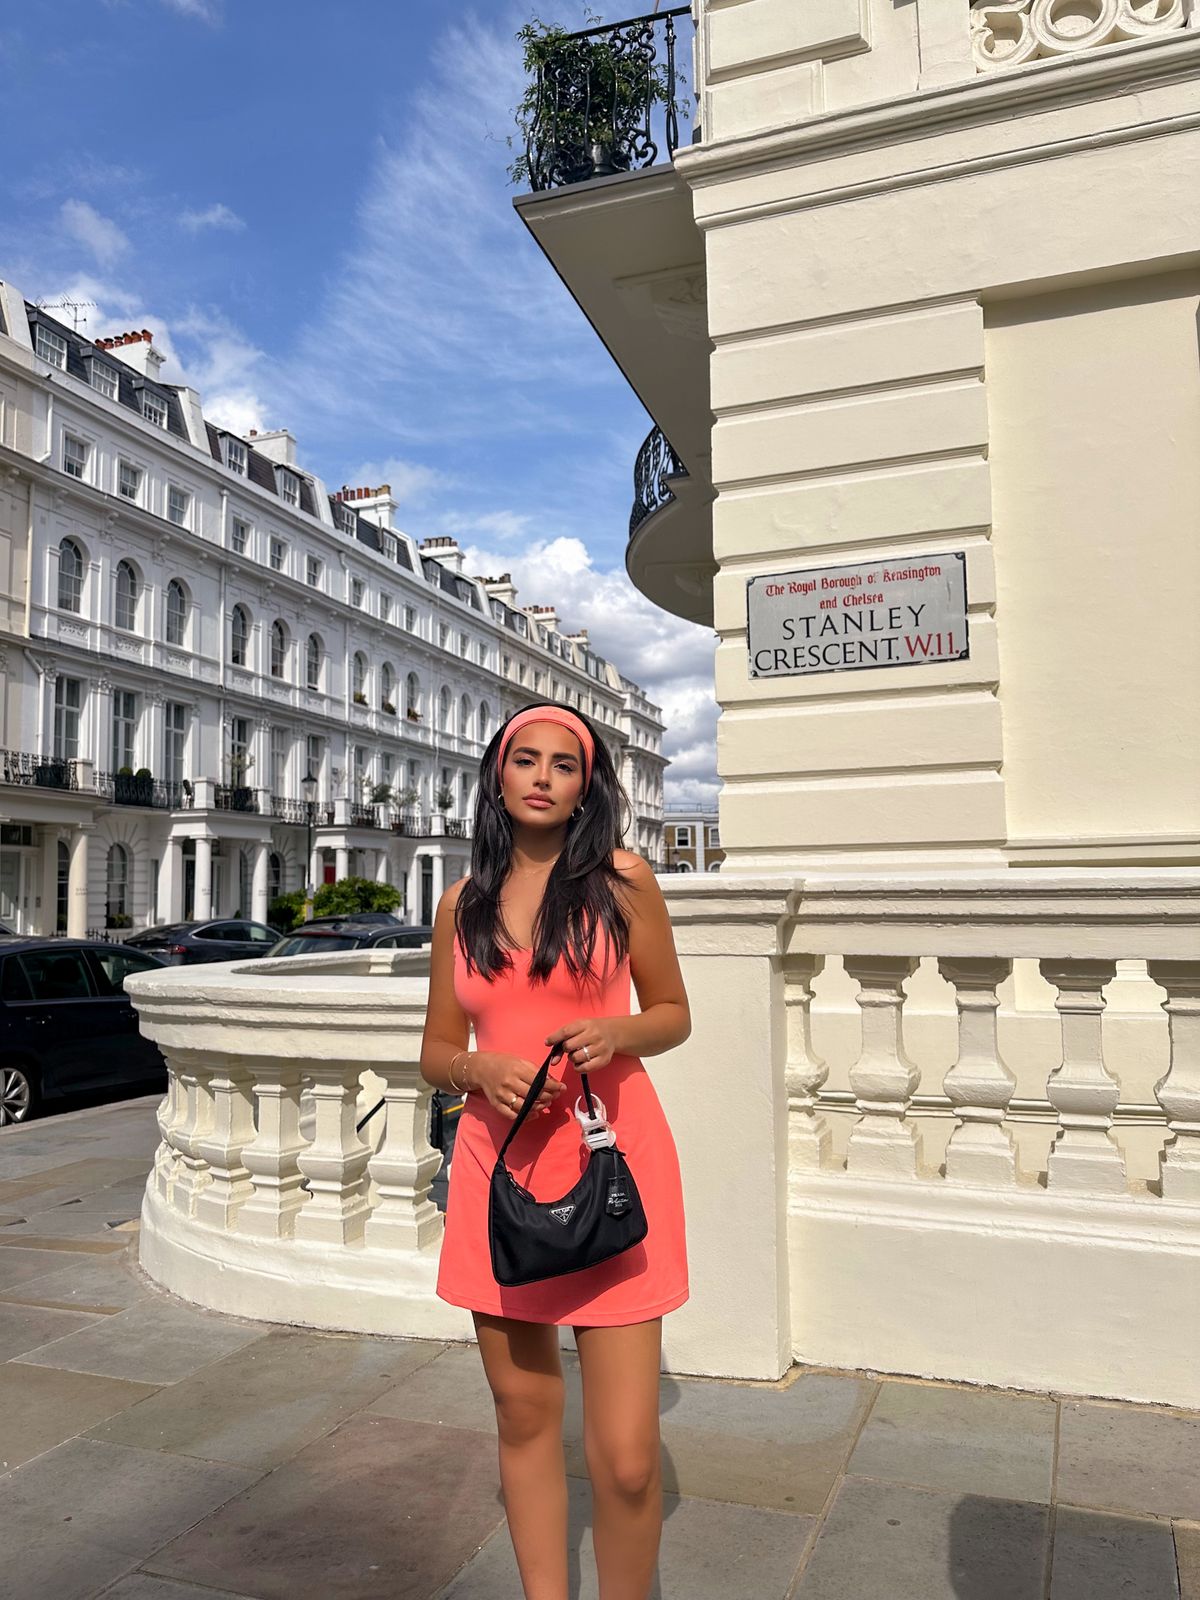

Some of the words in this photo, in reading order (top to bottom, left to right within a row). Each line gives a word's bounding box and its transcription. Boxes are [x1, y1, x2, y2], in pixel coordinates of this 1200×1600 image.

[766, 584, 785, 597] The
[787, 579, 817, 596] Royal
[821, 574, 862, 590] Borough
[883, 565, 941, 583] Kensington
[819, 596, 837, 610] and
[843, 593, 884, 607] Chelsea
[782, 604, 926, 640] STANLEY
[755, 637, 900, 671] CRESCENT,
[904, 631, 960, 658] W.11.
